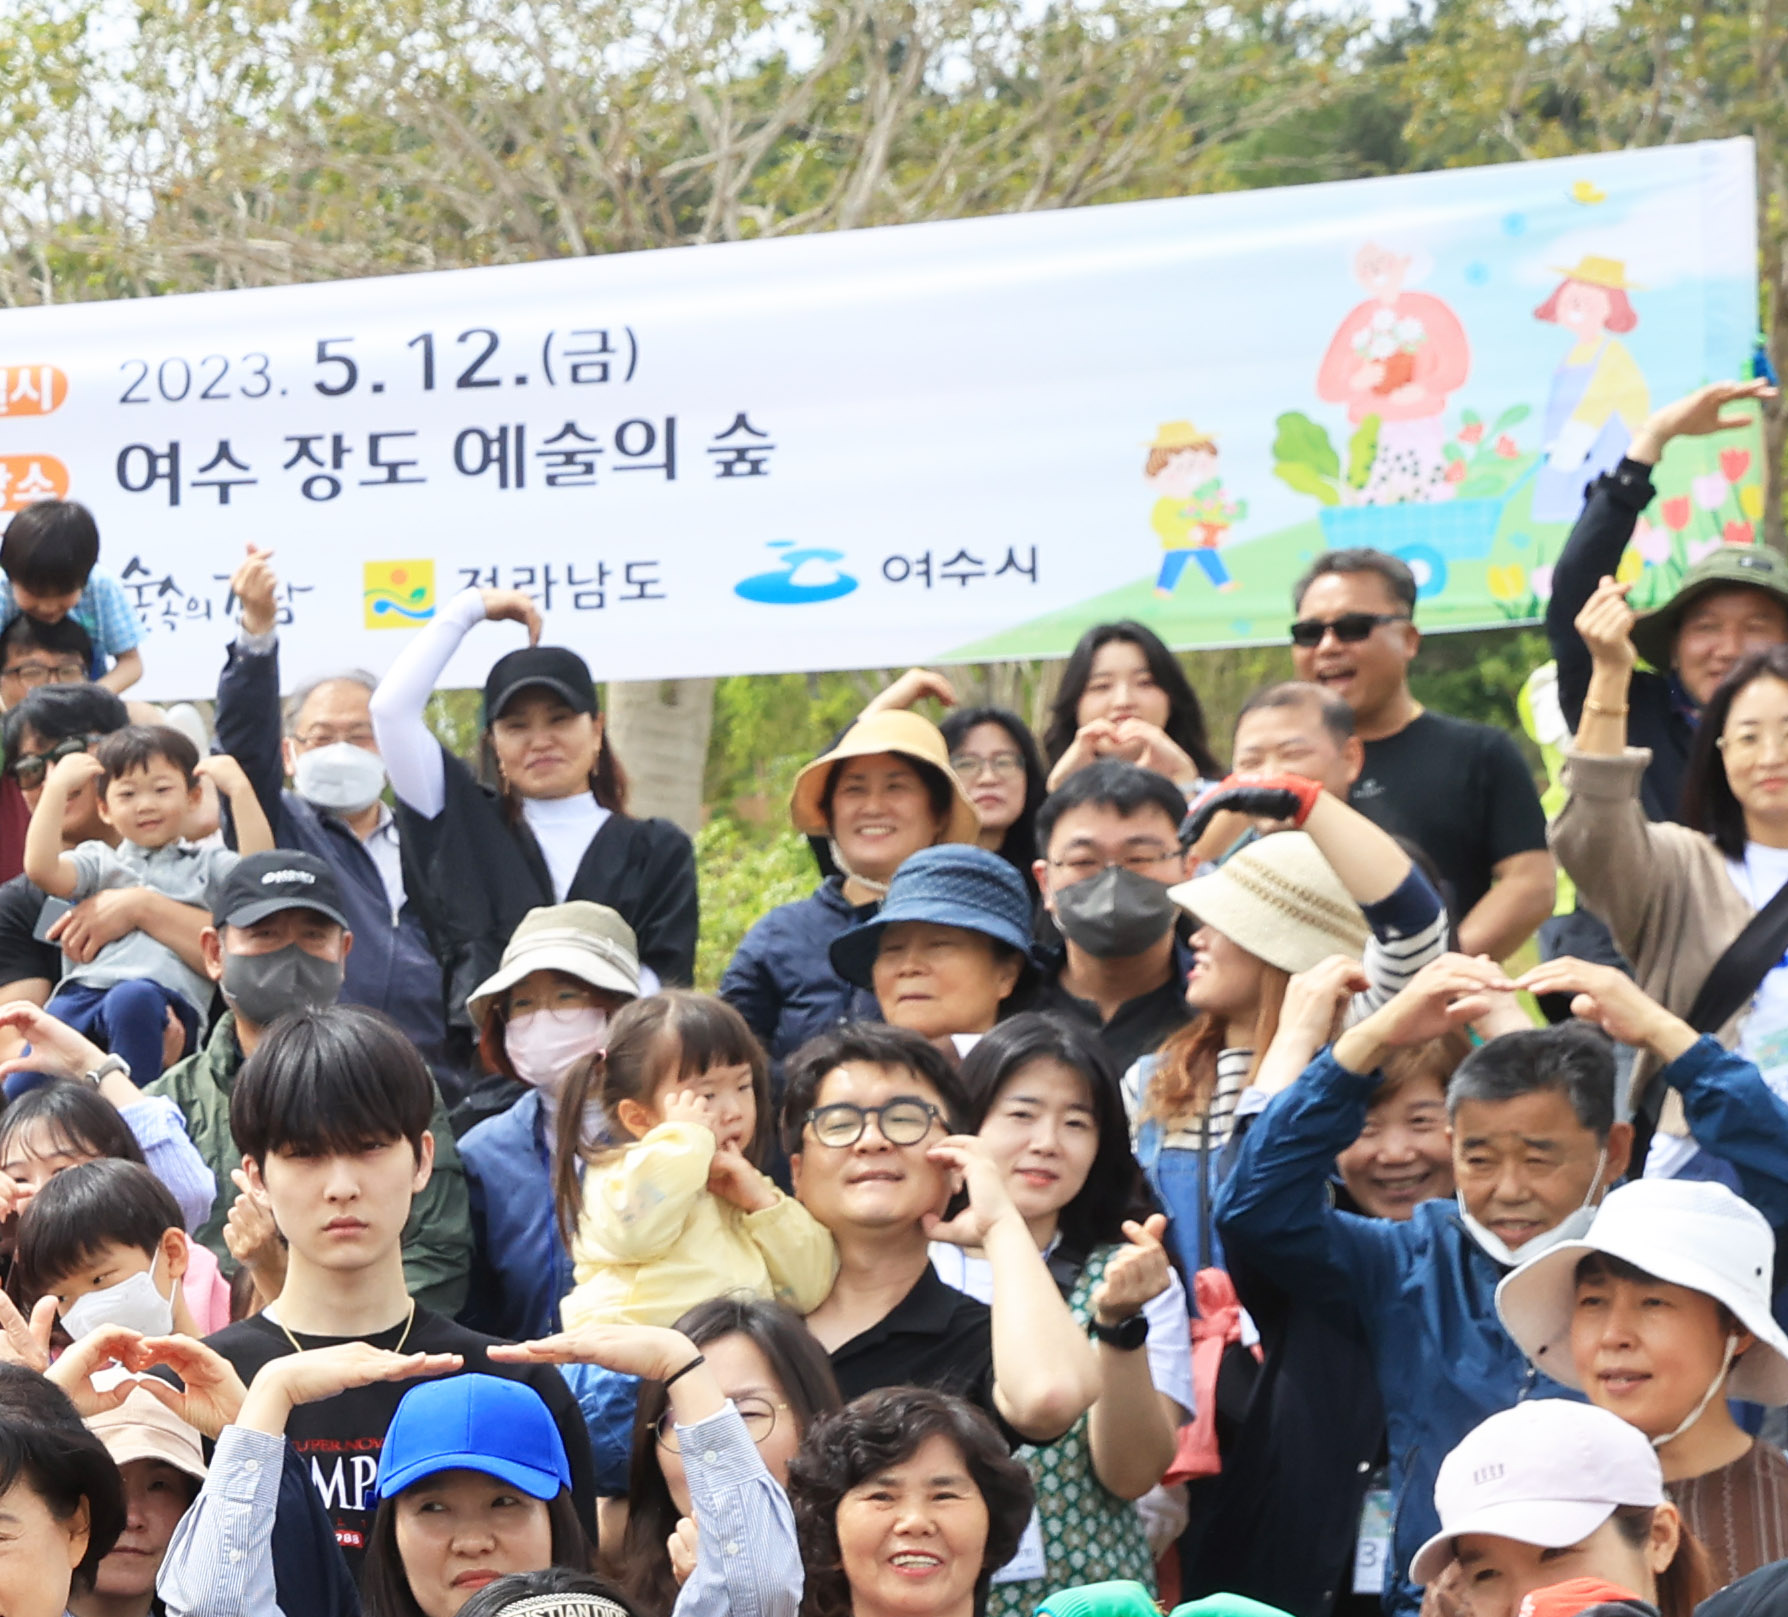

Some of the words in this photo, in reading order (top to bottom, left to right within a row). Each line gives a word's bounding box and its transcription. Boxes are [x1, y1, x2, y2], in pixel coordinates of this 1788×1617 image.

[118, 352, 289, 405] 2023.
[313, 325, 639, 397] 5.12.(금)
[116, 439, 258, 507] 여수
[282, 431, 427, 501] 장도
[453, 415, 678, 490] 예술의
[706, 411, 776, 478] 숲
[882, 544, 1039, 590] 여수시
